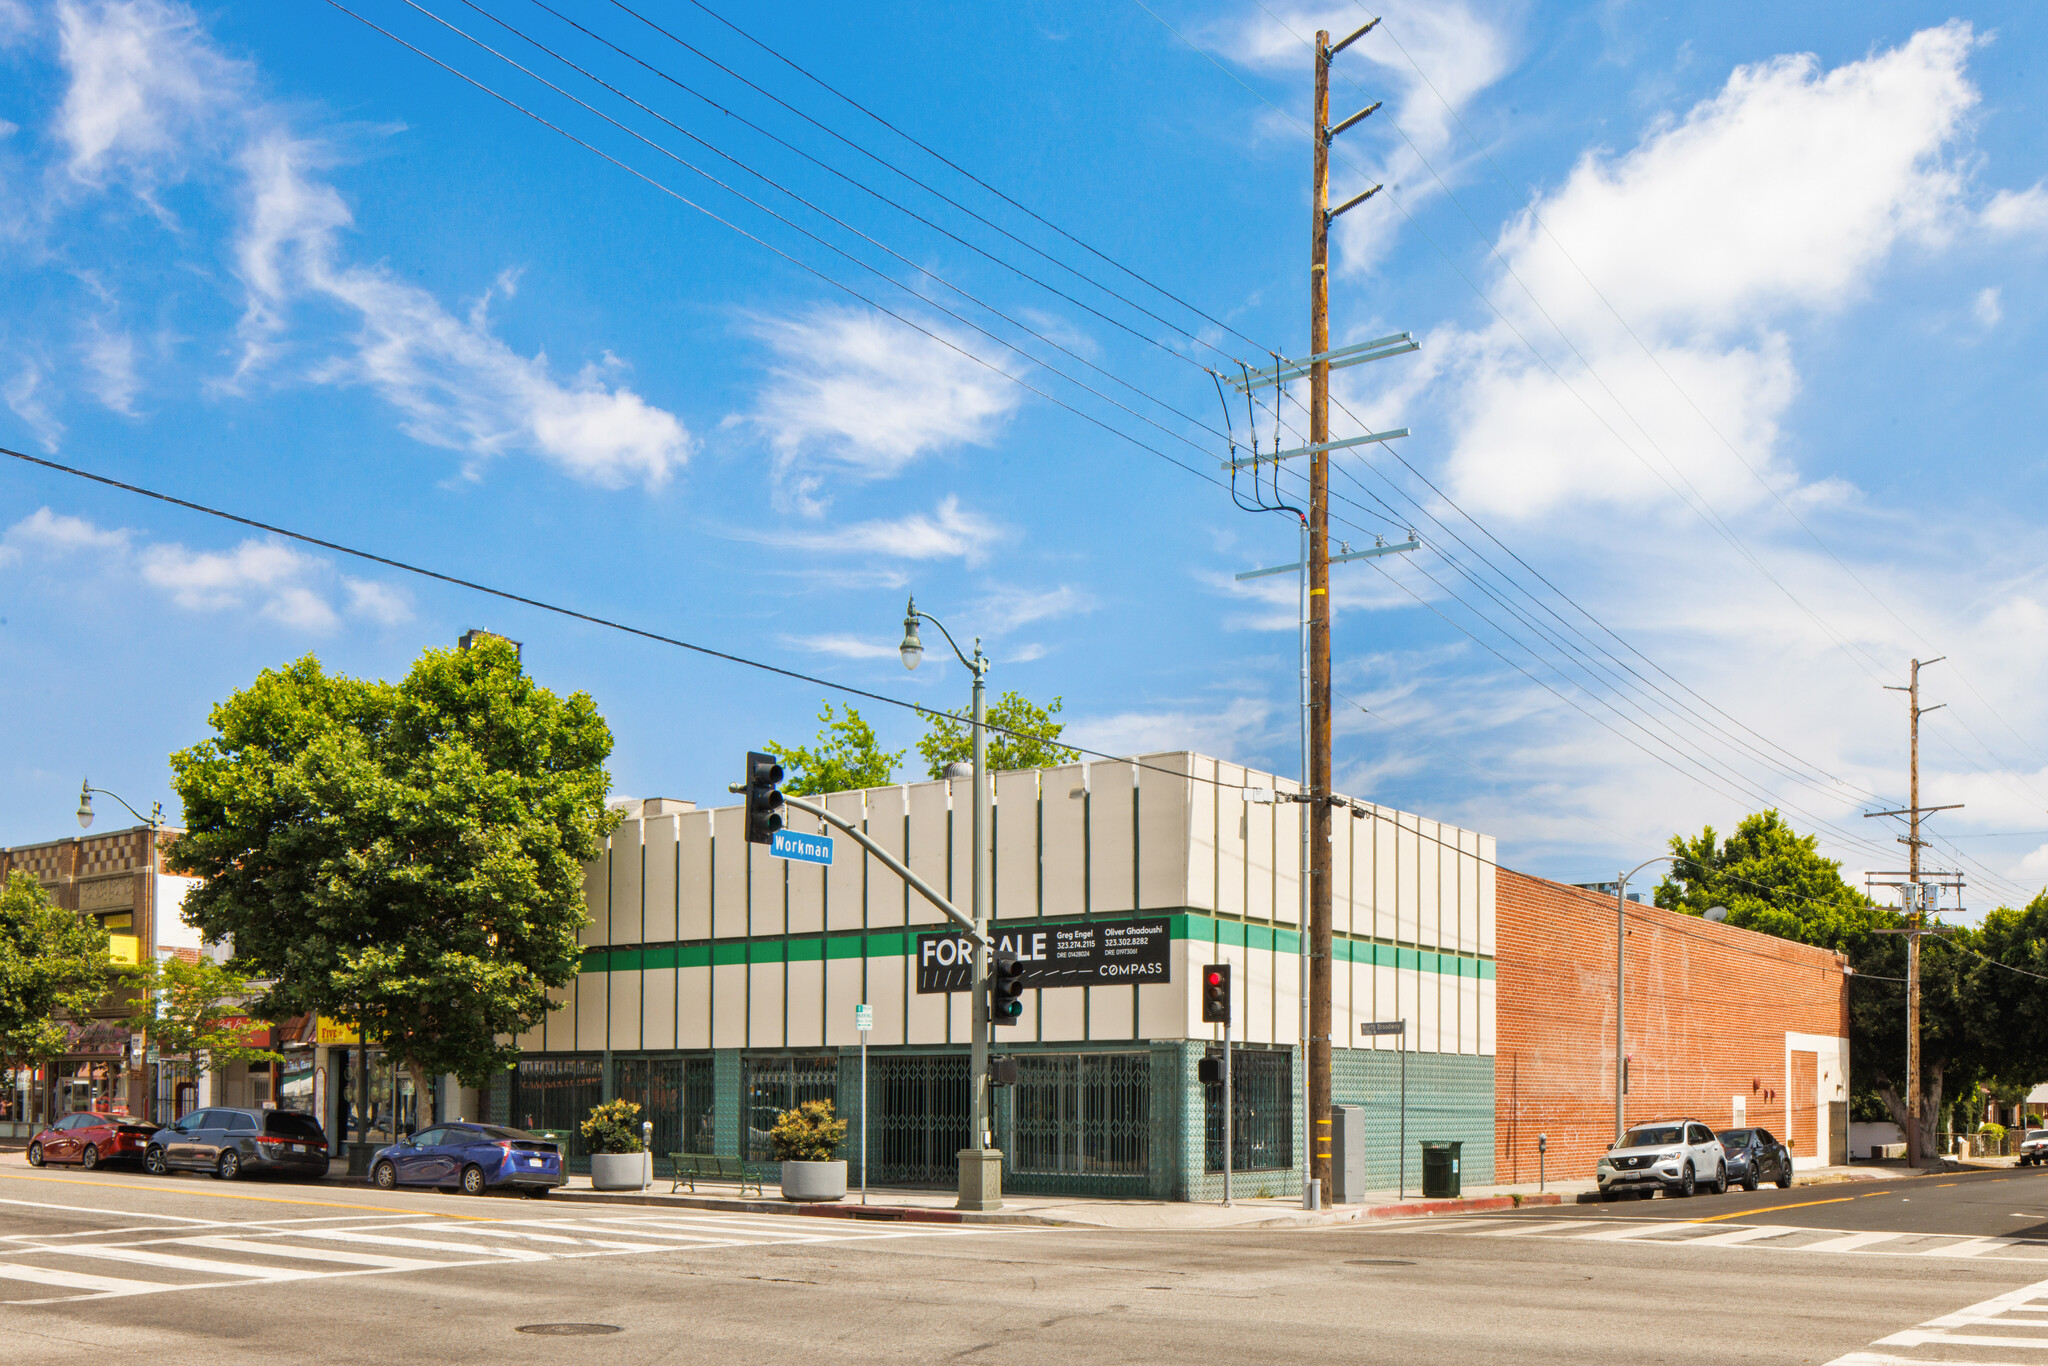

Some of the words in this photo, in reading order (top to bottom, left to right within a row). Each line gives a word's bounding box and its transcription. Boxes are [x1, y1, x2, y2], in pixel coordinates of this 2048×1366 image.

[775, 834, 829, 858] Workman
[1056, 931, 1074, 941] Greg
[1074, 929, 1094, 940] Engel
[1104, 928, 1126, 937] Oliver
[1126, 925, 1163, 936] Ghadoushi
[1057, 940, 1096, 950] 323.274.2115
[1104, 937, 1149, 947] 323.302.8282
[923, 938, 973, 967] FOR
[985, 932, 1046, 963] SALE
[1056, 951, 1068, 959] DRE
[1099, 962, 1163, 976] COMPASS
[1377, 1023, 1401, 1031] Broadway
